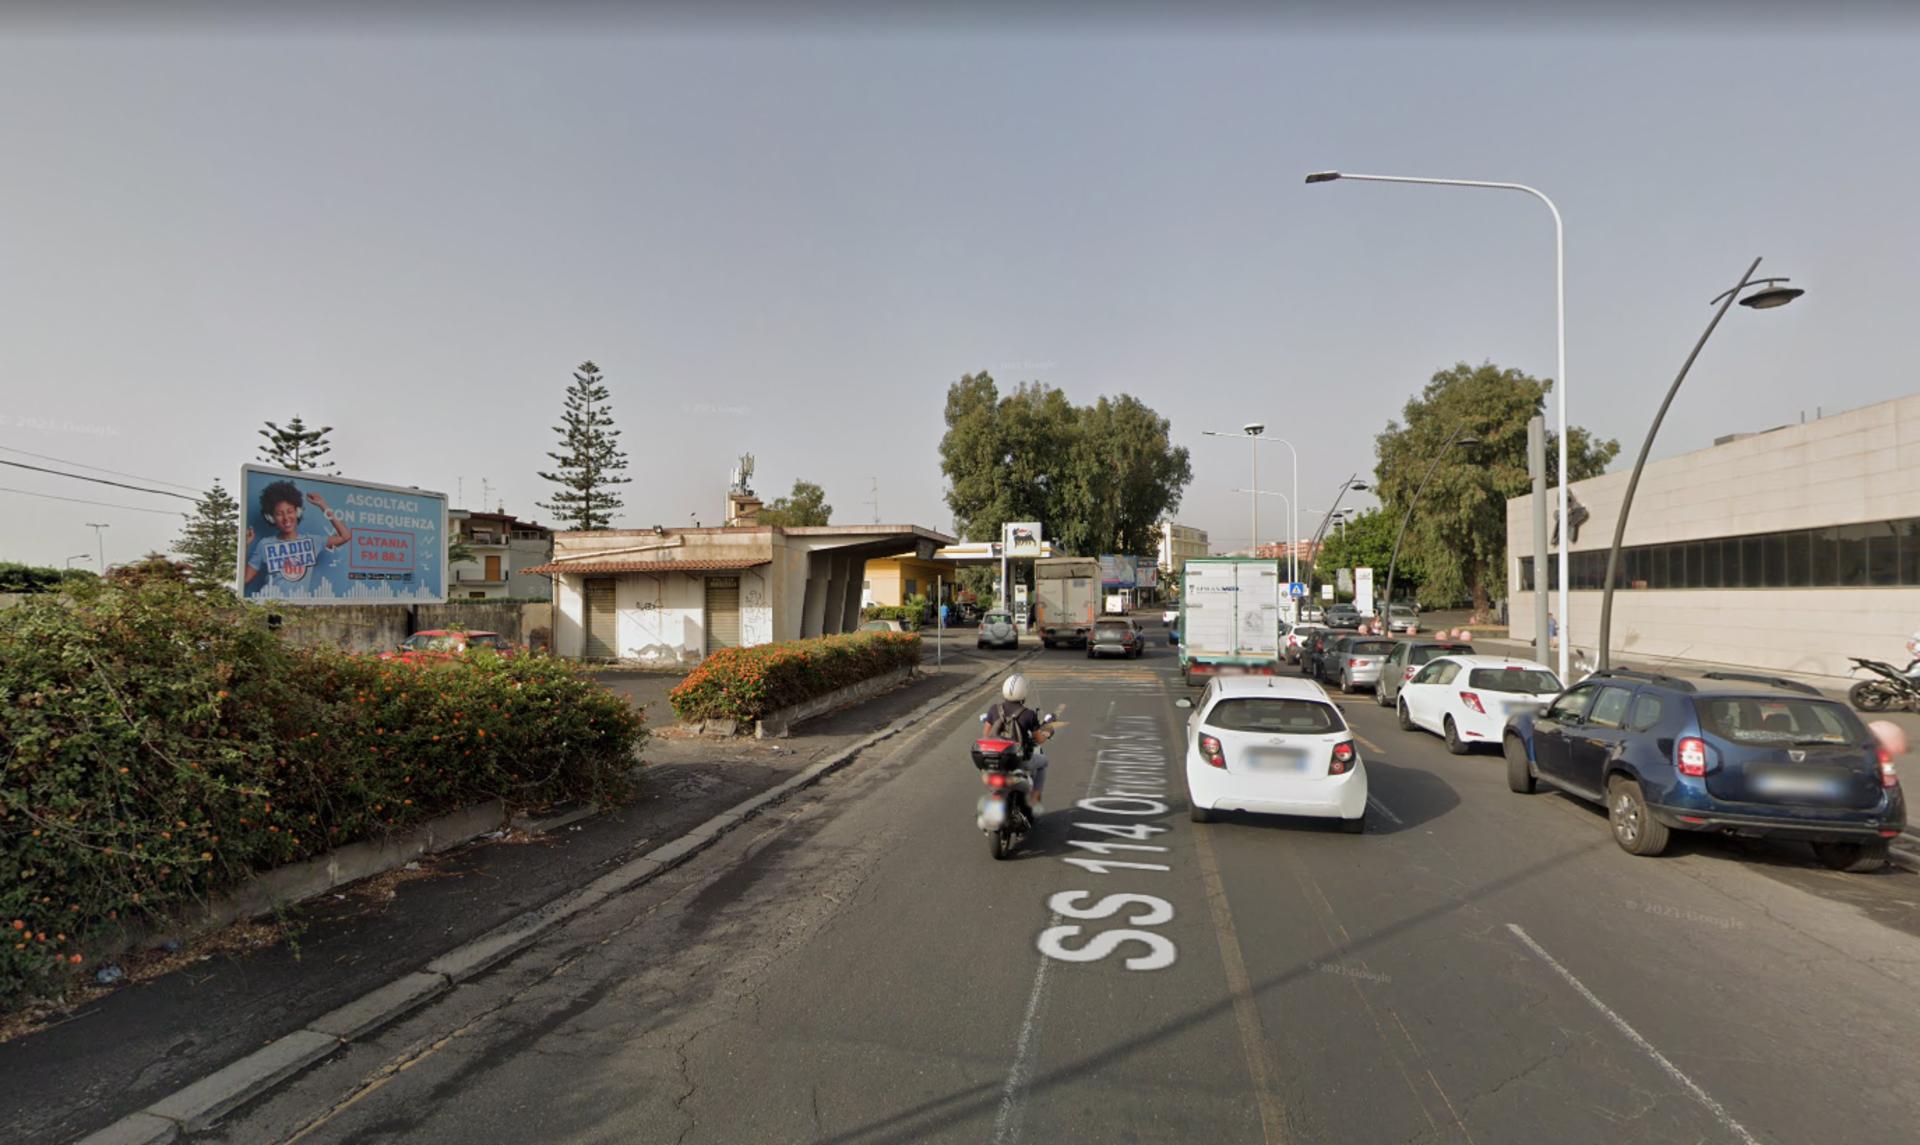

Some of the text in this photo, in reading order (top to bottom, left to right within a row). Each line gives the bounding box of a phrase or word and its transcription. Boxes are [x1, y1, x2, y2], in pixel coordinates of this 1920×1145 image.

[345, 494, 419, 513] ASCOLTACI
[324, 508, 436, 530] CON FREQUENZA
[266, 540, 313, 558] RADIO
[358, 536, 409, 549] CATANIA
[361, 551, 379, 561] FM
